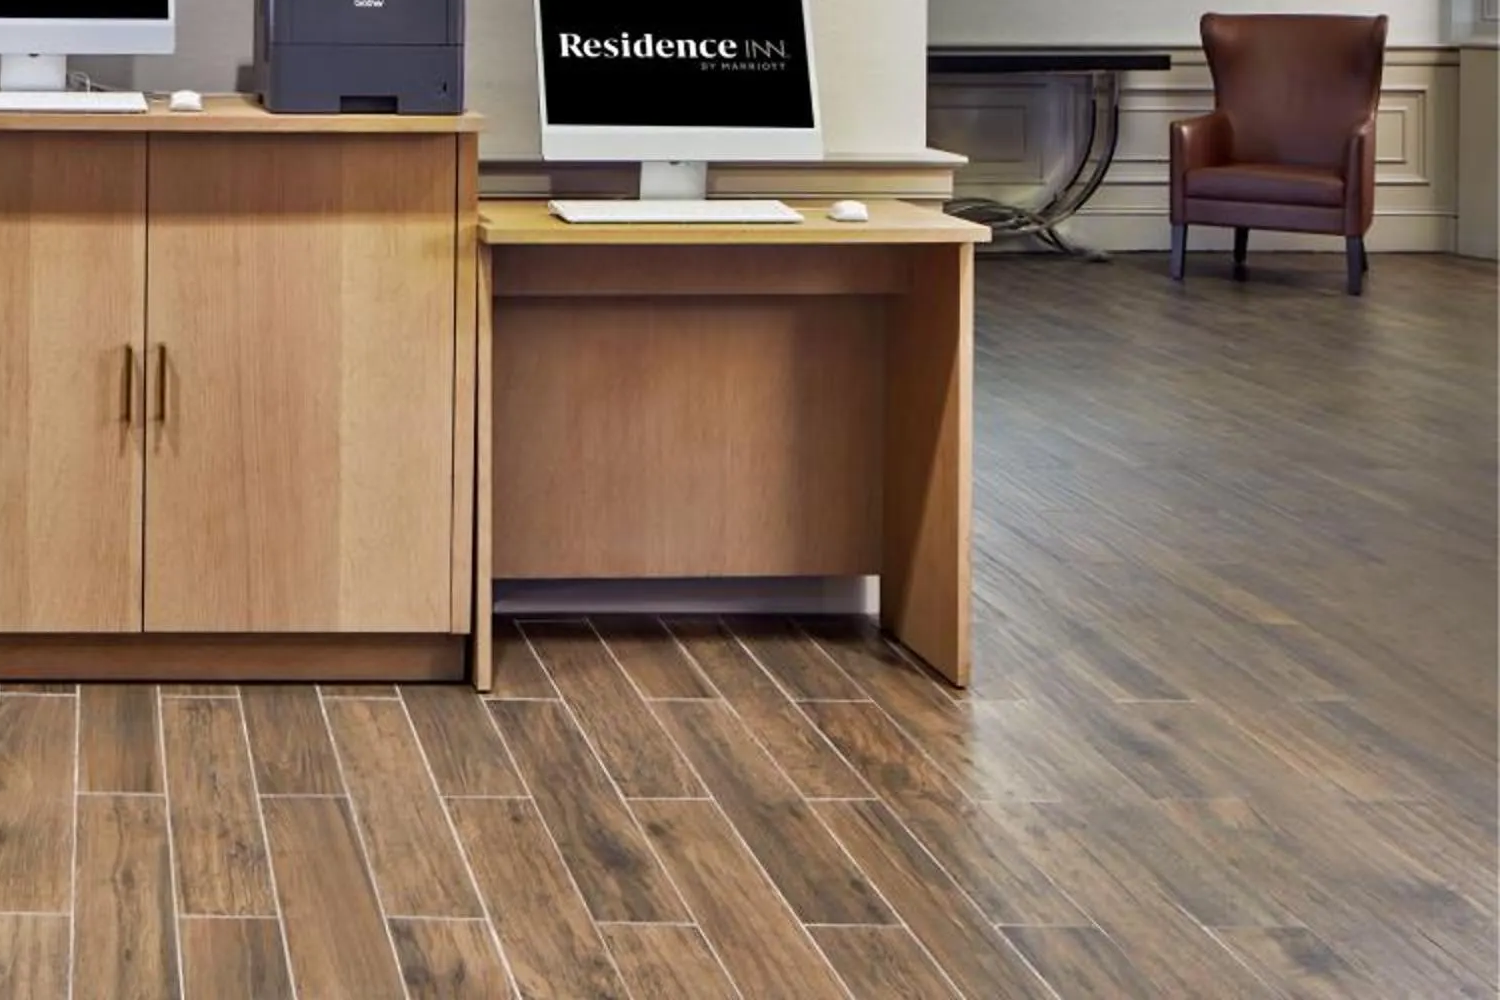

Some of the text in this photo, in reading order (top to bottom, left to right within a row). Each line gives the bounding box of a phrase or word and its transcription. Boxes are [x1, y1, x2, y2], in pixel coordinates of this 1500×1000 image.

[559, 32, 738, 59] Residence
[701, 62, 786, 71] BY MARRIOTT
